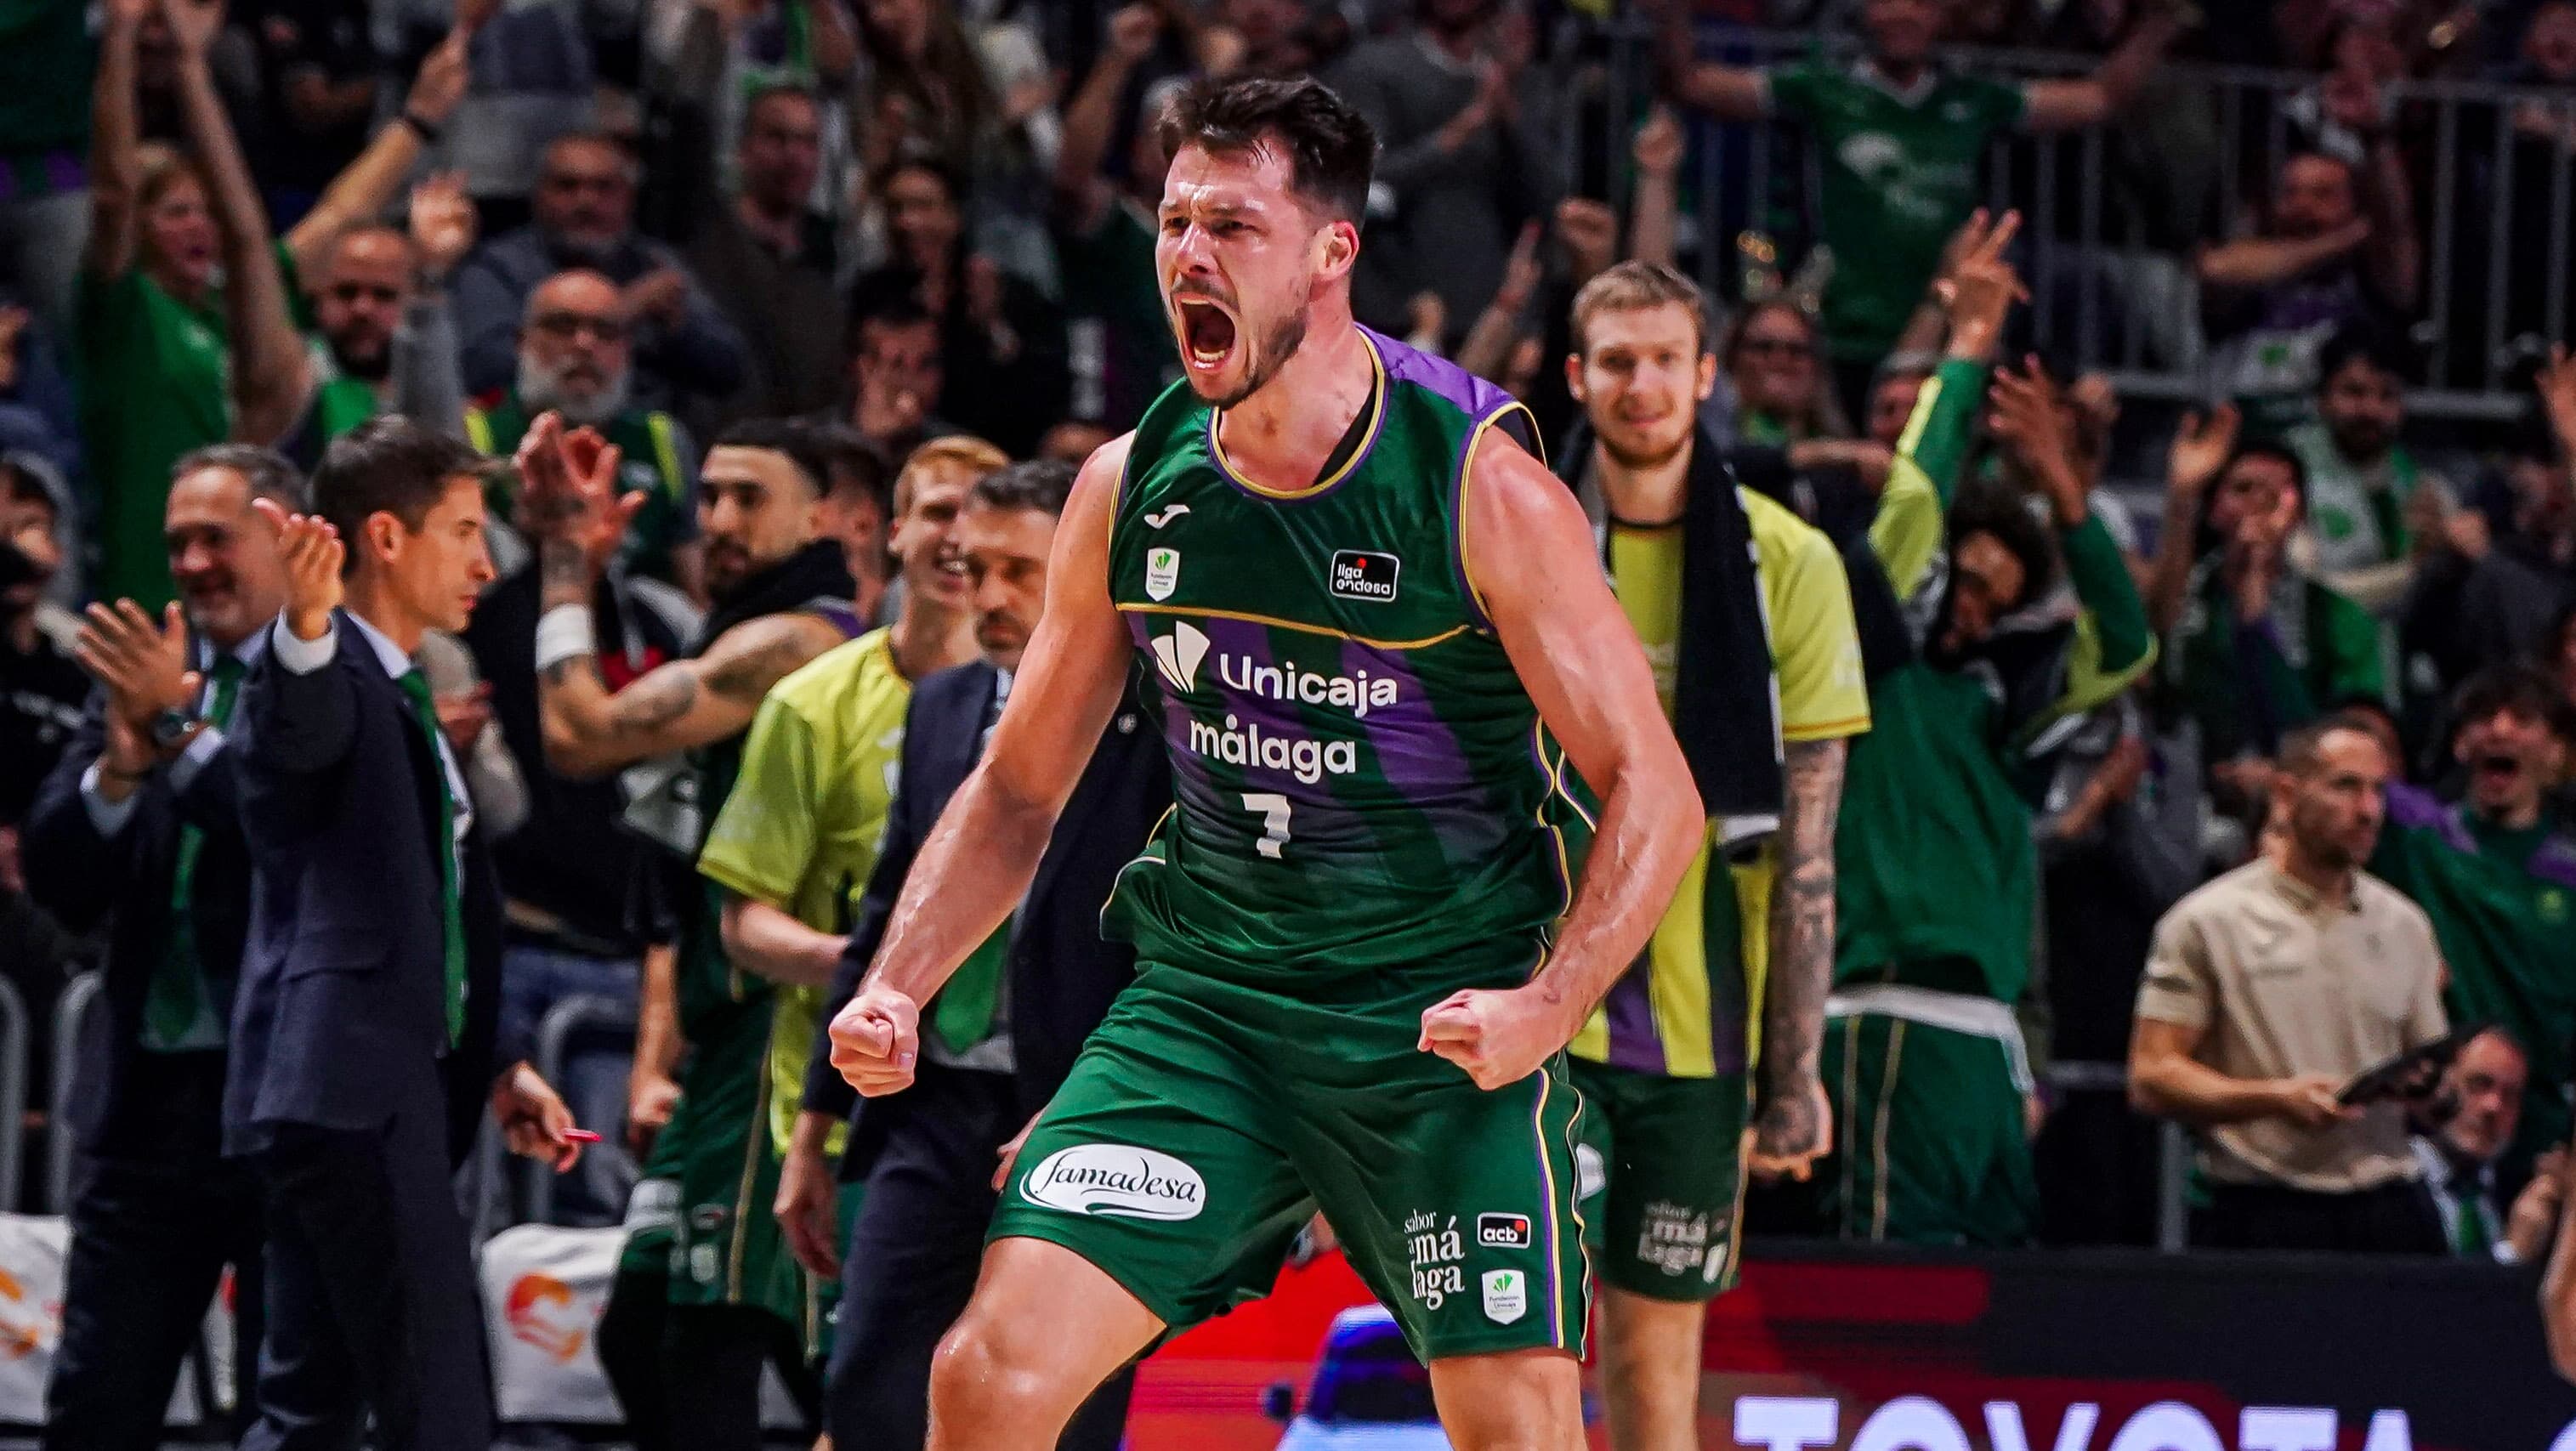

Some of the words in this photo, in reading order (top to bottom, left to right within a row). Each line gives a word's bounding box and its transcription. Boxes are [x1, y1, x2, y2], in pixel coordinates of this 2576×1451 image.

[1220, 653, 1399, 719] Unicaja
[1240, 792, 1291, 859] 7
[1040, 1150, 1196, 1203] famadesa
[1404, 1208, 1438, 1234] sabor
[1483, 1226, 1518, 1243] acb
